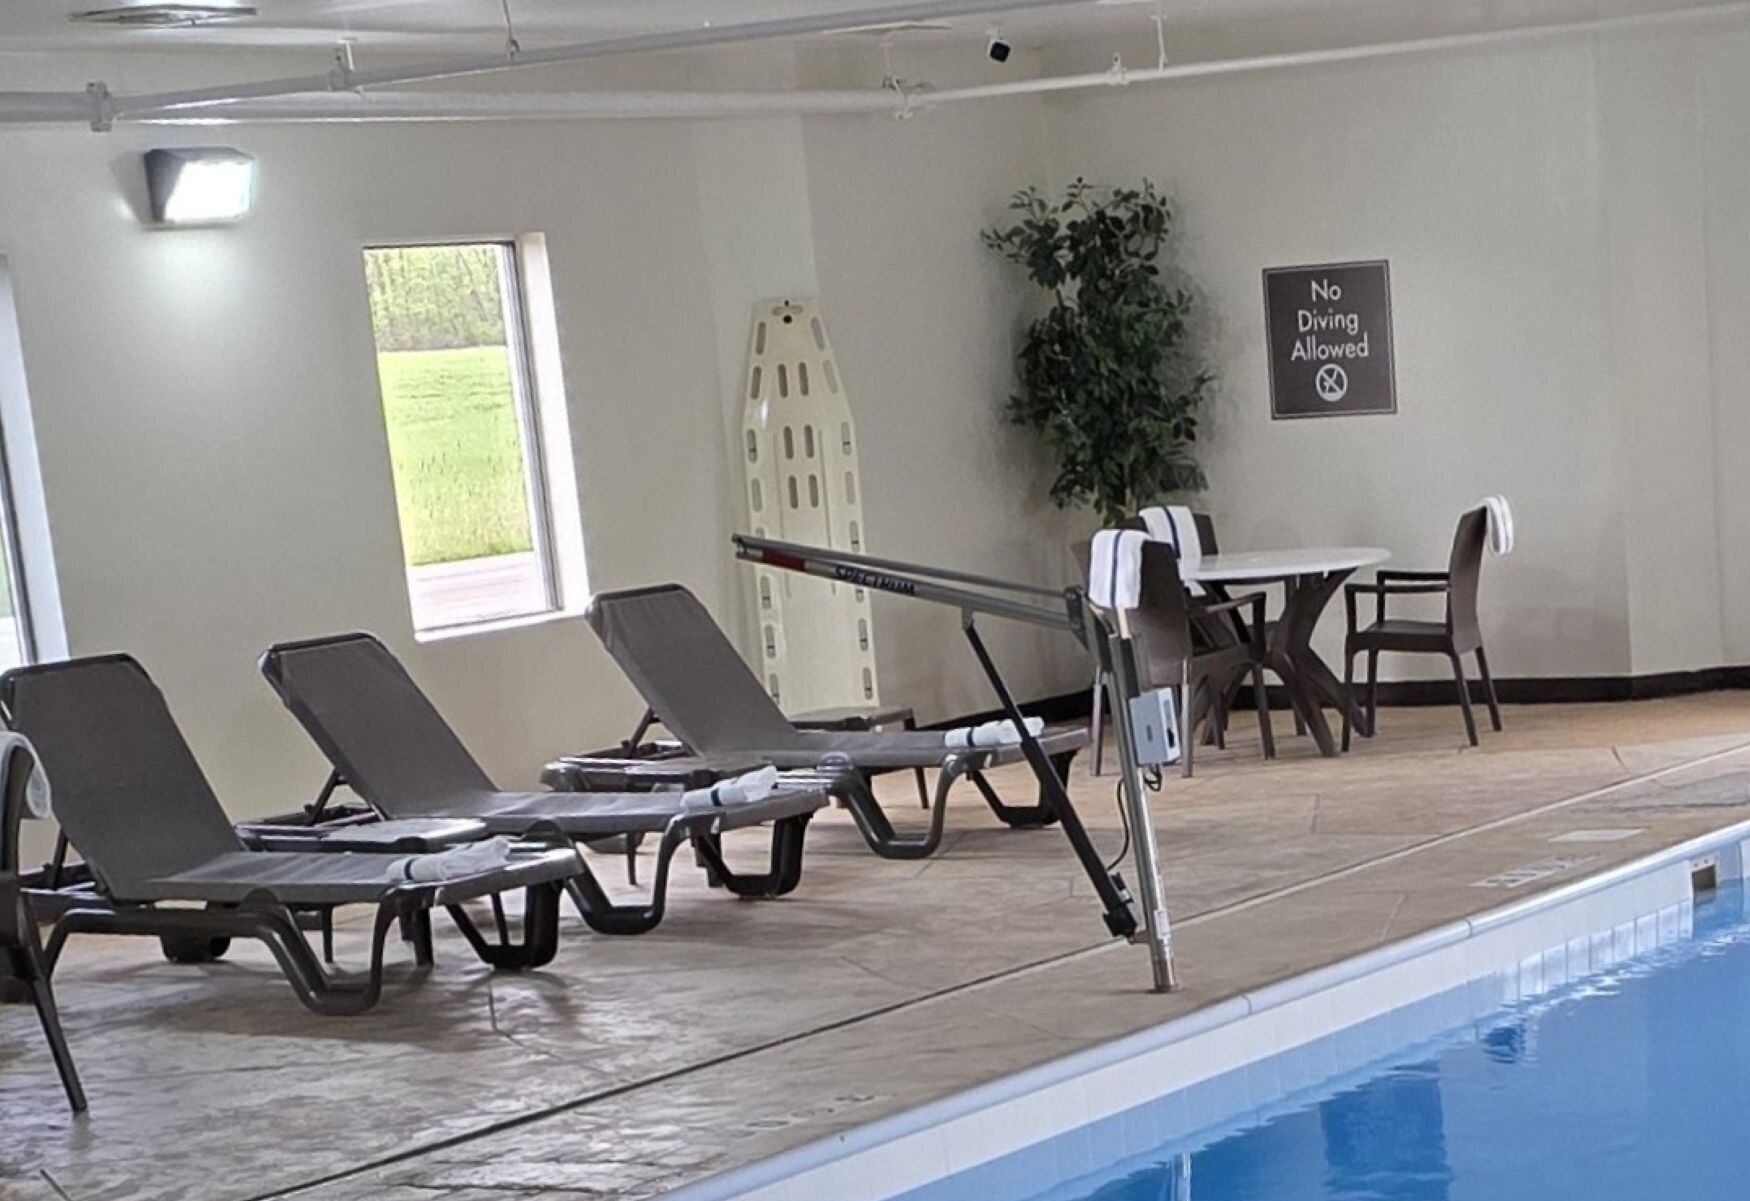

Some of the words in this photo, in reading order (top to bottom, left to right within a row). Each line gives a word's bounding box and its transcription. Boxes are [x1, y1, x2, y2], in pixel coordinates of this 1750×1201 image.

[1311, 279, 1342, 301] No
[1297, 308, 1359, 335] Diving
[1291, 331, 1369, 361] Allowed
